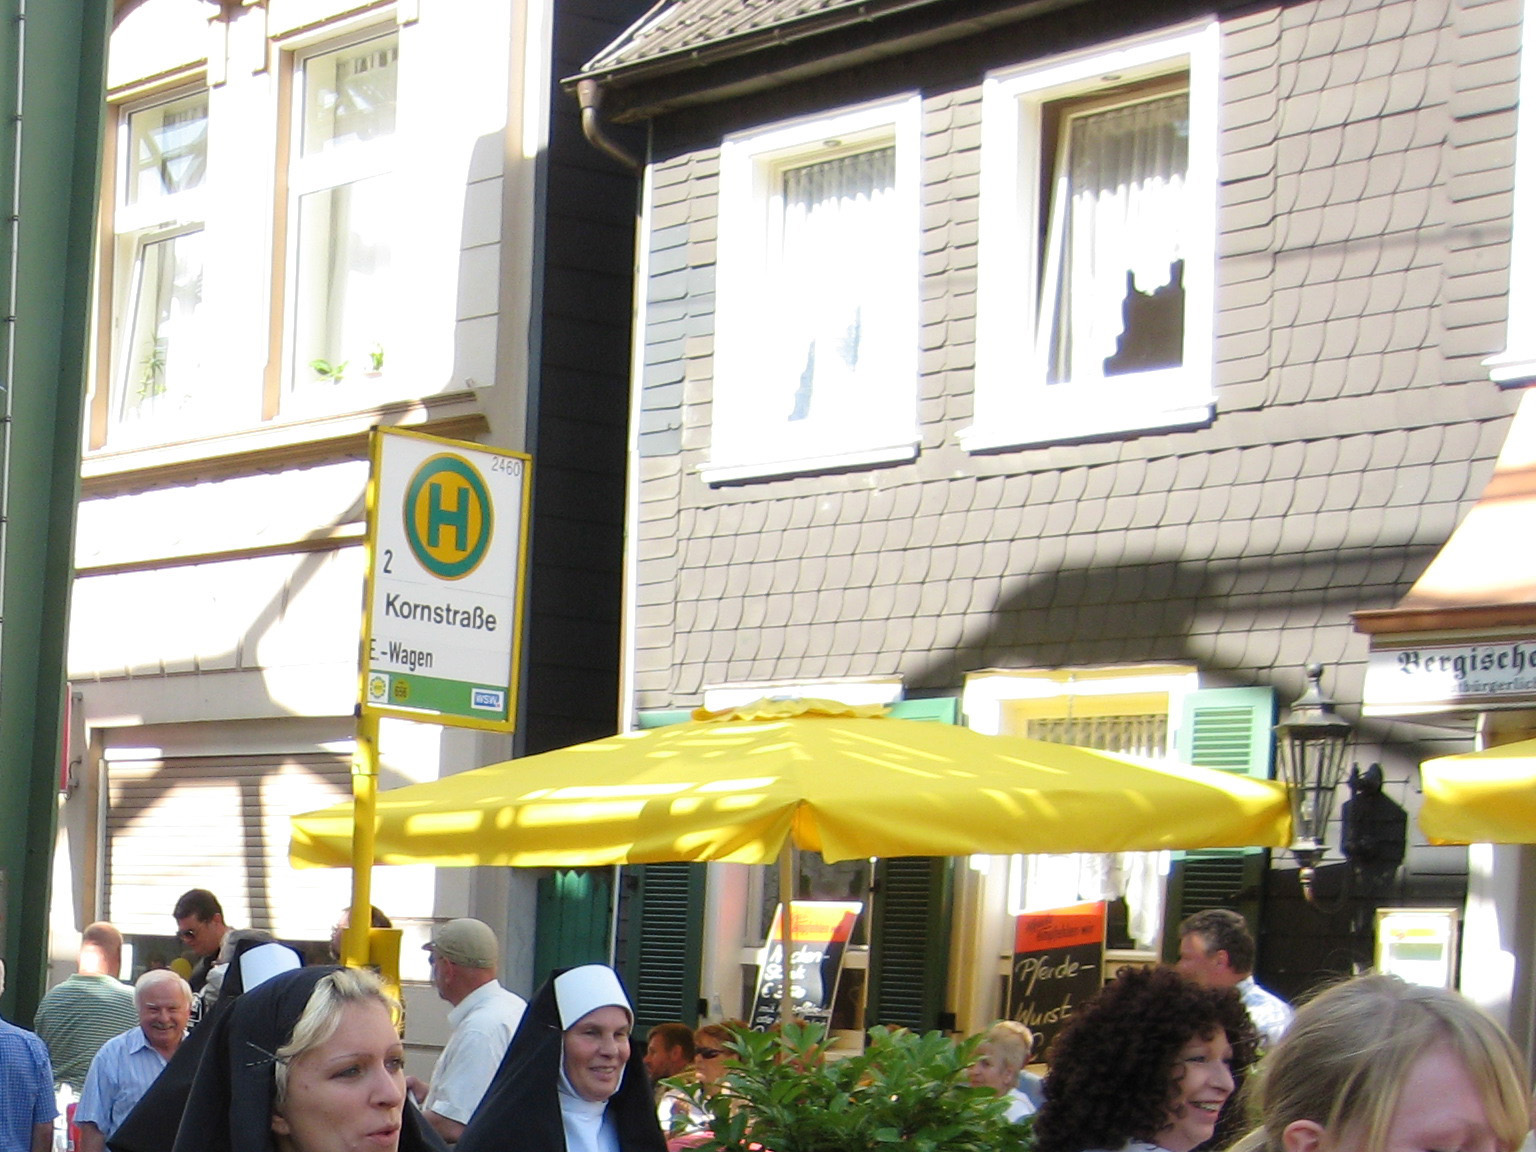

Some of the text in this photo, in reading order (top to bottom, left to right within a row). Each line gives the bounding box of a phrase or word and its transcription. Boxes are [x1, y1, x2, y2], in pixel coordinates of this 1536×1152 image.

[491, 456, 521, 477] 2460
[428, 483, 469, 551] H
[383, 549, 393, 574] 2
[385, 593, 497, 632] Kornstraße
[1014, 955, 1096, 997] Pferde-
[1014, 993, 1073, 1027] Wurst
